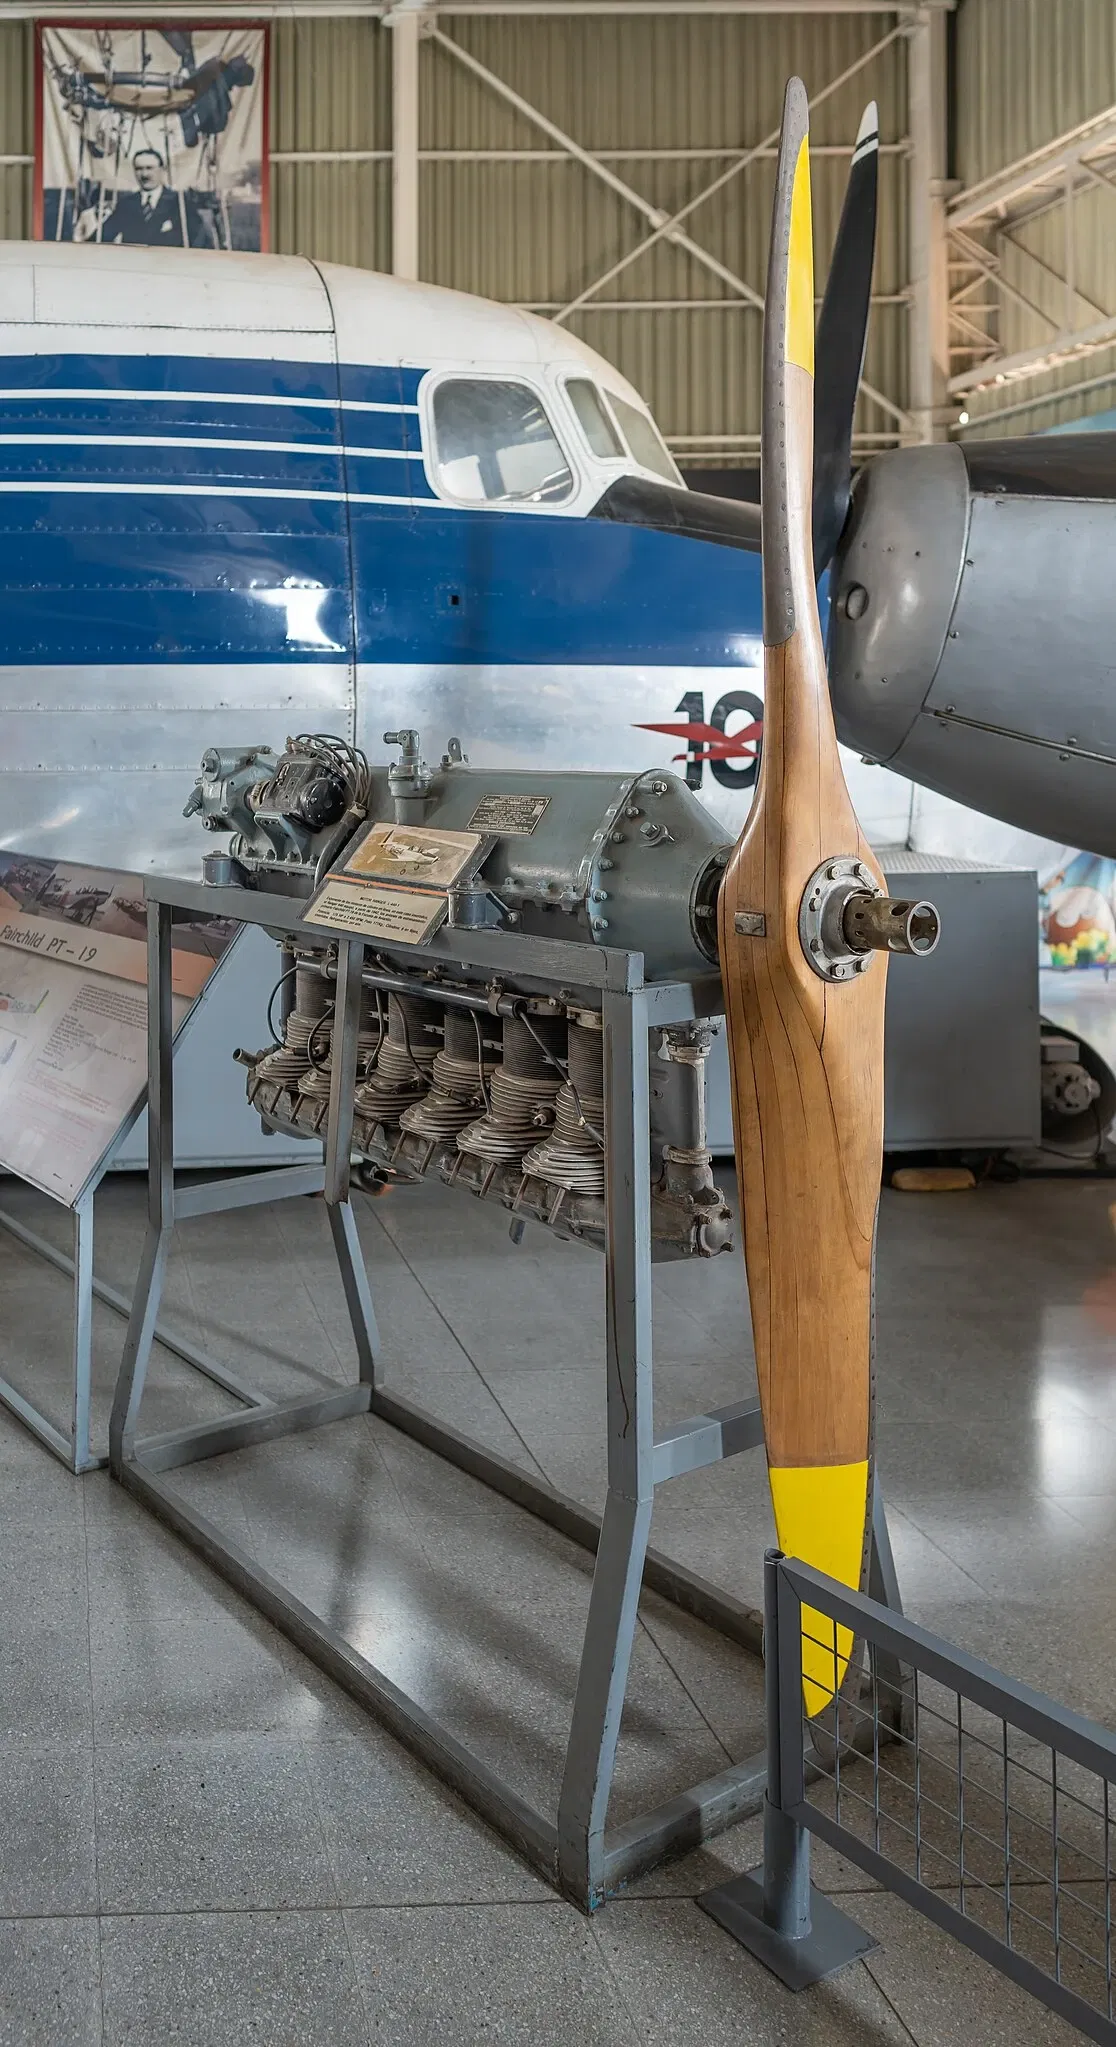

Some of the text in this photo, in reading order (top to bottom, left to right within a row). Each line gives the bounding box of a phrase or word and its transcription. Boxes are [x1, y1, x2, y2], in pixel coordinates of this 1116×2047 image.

[0, 924, 46, 948] Fairchild
[46, 938, 67, 954] PT
[78, 946, 97, 962] 19
